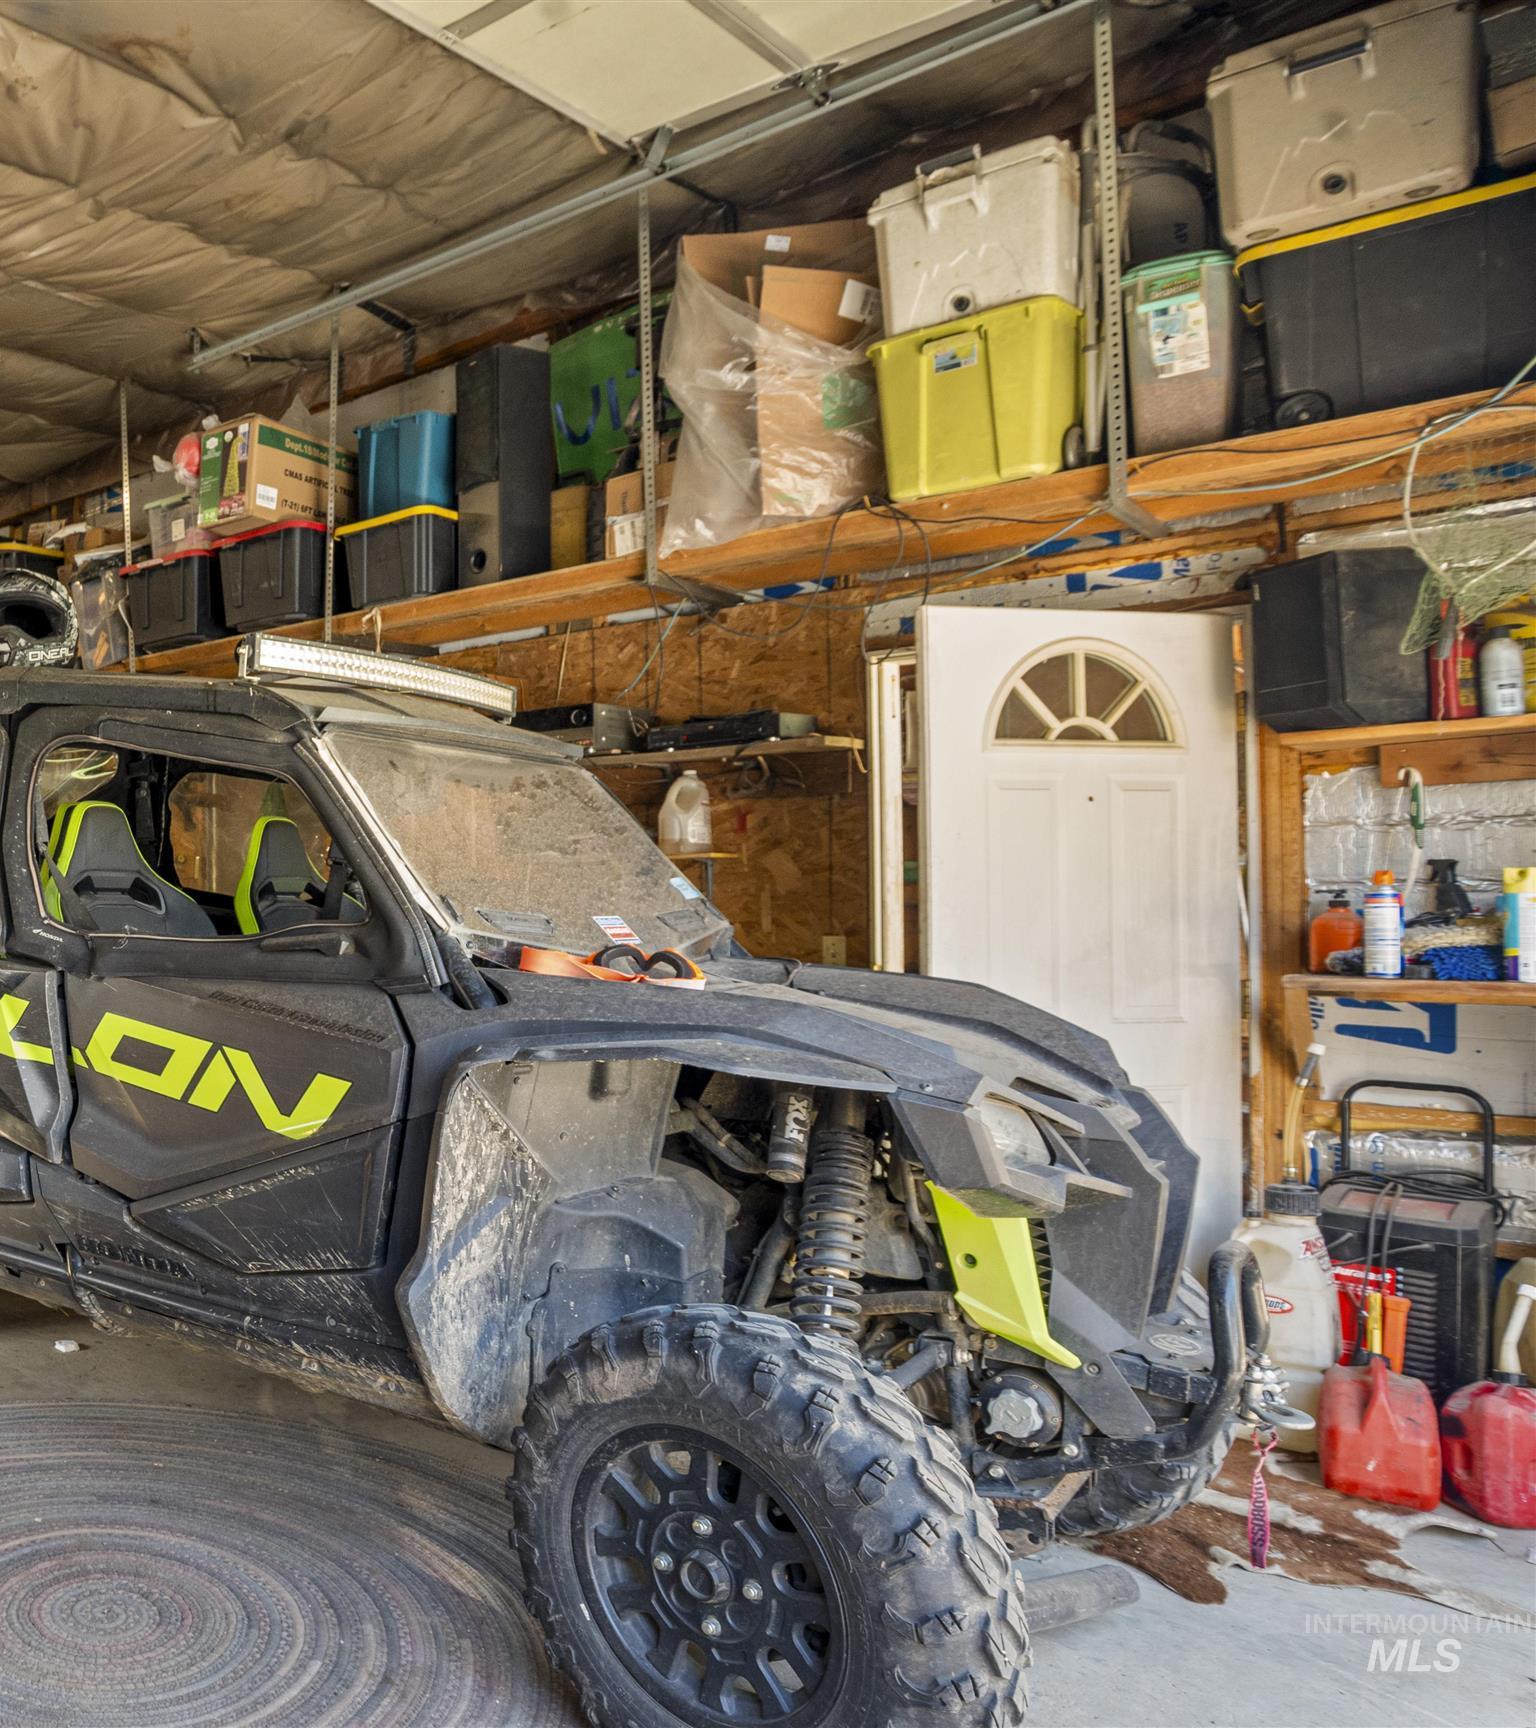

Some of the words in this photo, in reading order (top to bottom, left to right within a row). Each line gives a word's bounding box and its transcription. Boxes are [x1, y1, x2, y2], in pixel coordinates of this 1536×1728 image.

[284, 468, 303, 482] CMAS
[39, 931, 64, 943] HONDA
[785, 1095, 811, 1143] FOX
[77, 1235, 196, 1282] HONDA
